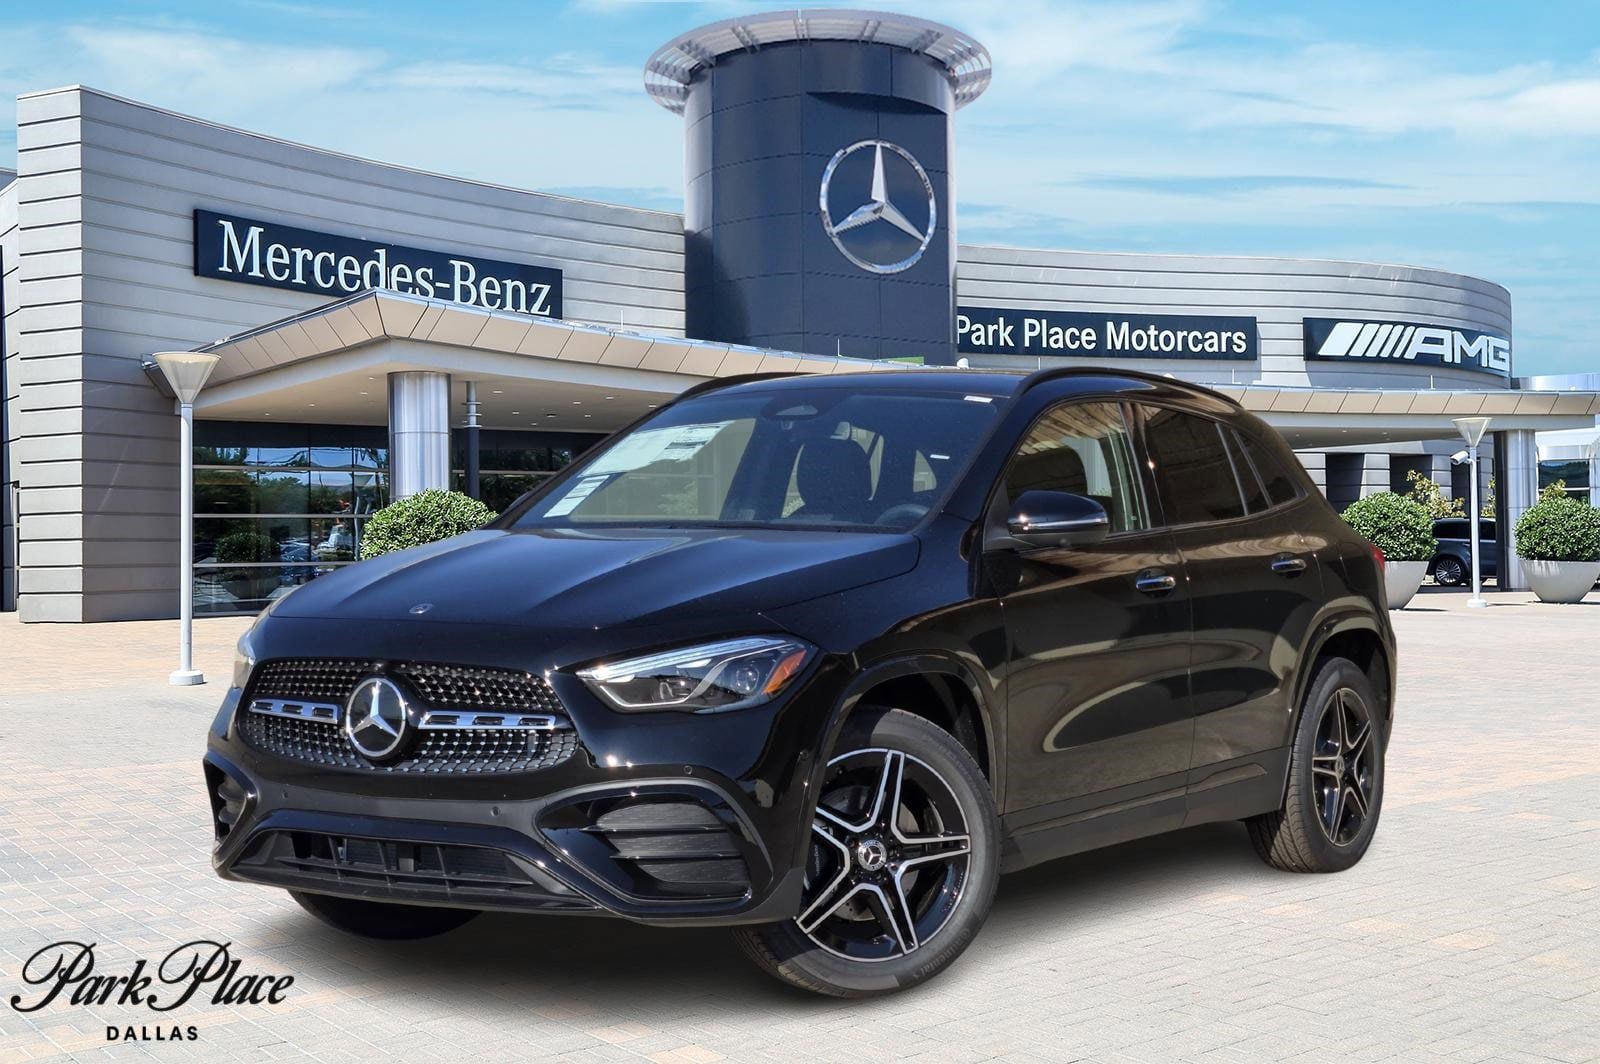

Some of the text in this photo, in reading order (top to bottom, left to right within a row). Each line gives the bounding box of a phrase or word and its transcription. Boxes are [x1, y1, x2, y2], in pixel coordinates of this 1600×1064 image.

[218, 219, 552, 317] Mercedes-Benz
[956, 315, 1248, 354] Park Place Motorcars
[1403, 326, 1510, 373] AMG
